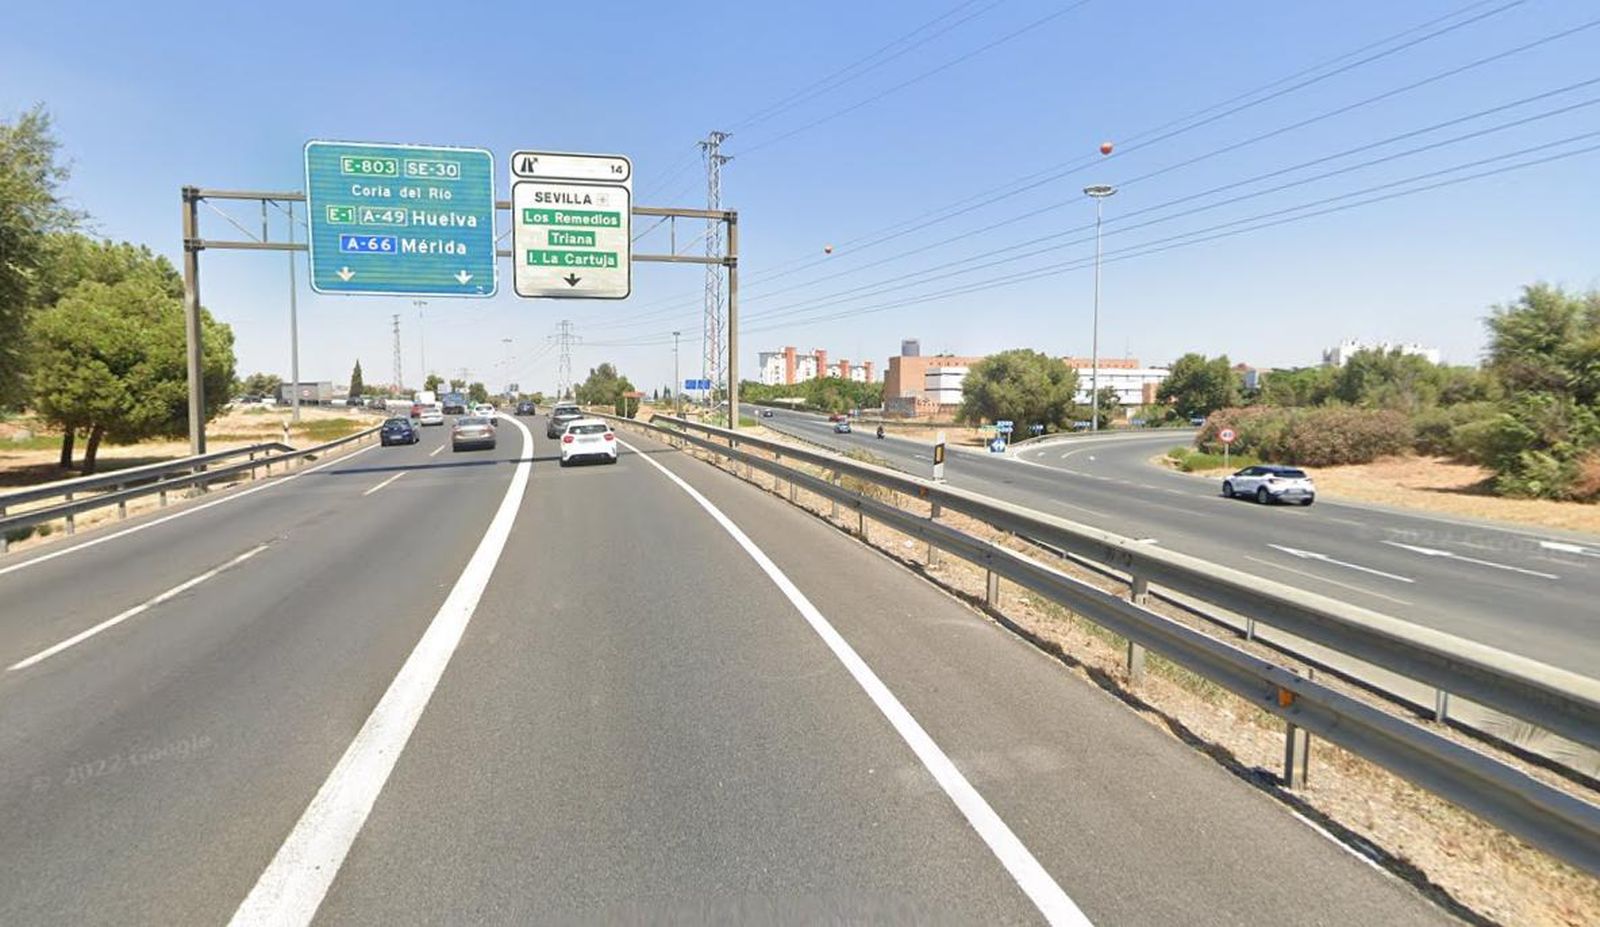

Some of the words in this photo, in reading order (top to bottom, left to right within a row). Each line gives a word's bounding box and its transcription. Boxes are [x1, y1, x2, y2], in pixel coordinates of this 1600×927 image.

[344, 160, 396, 174] E-803
[407, 162, 458, 177] SE-30
[611, 165, 622, 174] 14
[351, 185, 391, 198] Coria
[399, 185, 421, 199] del
[535, 191, 592, 204] SEVILLA
[329, 209, 353, 222] E-1
[363, 210, 406, 224] A-49
[413, 211, 477, 227] Huelva
[525, 211, 549, 224] Los
[555, 213, 618, 226] Remedios
[346, 237, 392, 251] A-66
[401, 239, 467, 255] Mérida
[552, 232, 592, 245] Triana
[543, 252, 559, 264] La
[564, 253, 615, 268] Cartuja
